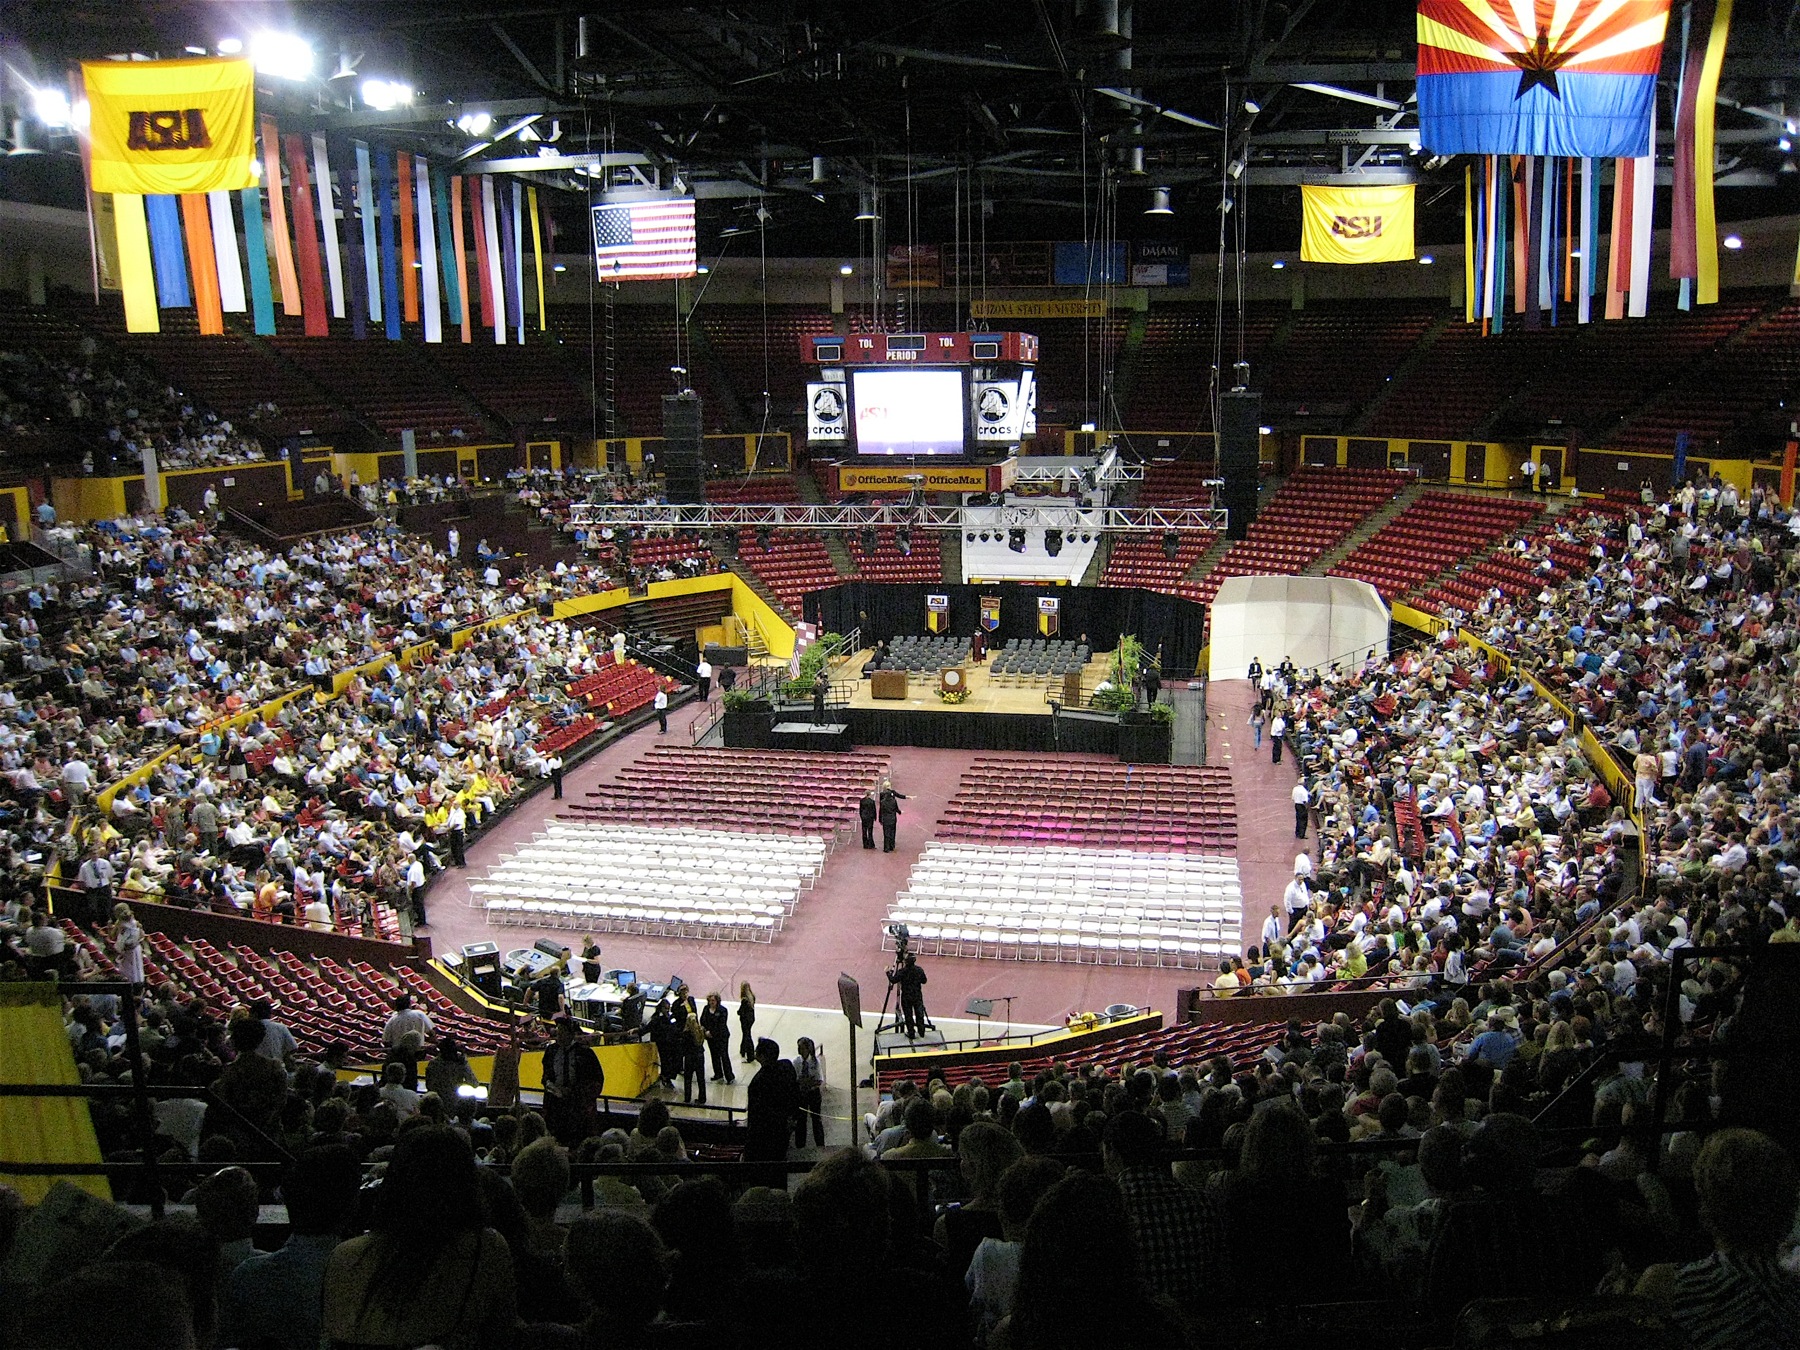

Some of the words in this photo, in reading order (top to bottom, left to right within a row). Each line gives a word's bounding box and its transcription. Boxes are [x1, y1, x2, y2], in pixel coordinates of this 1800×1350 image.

[1331, 215, 1382, 238] ASU
[1142, 246, 1179, 257] DASANI
[975, 303, 1013, 314] ARIZONA
[1018, 303, 1043, 315] STATE
[1047, 302, 1102, 314] UNIVERSITY
[859, 339, 873, 348] TOL
[939, 337, 954, 347] TOL
[886, 351, 917, 360] PERIOD
[813, 426, 846, 434] crocs
[978, 426, 1012, 435] crocs
[858, 475, 904, 484] OfficeMa
[928, 475, 982, 485] OfficeMax
[930, 597, 945, 605] ASU
